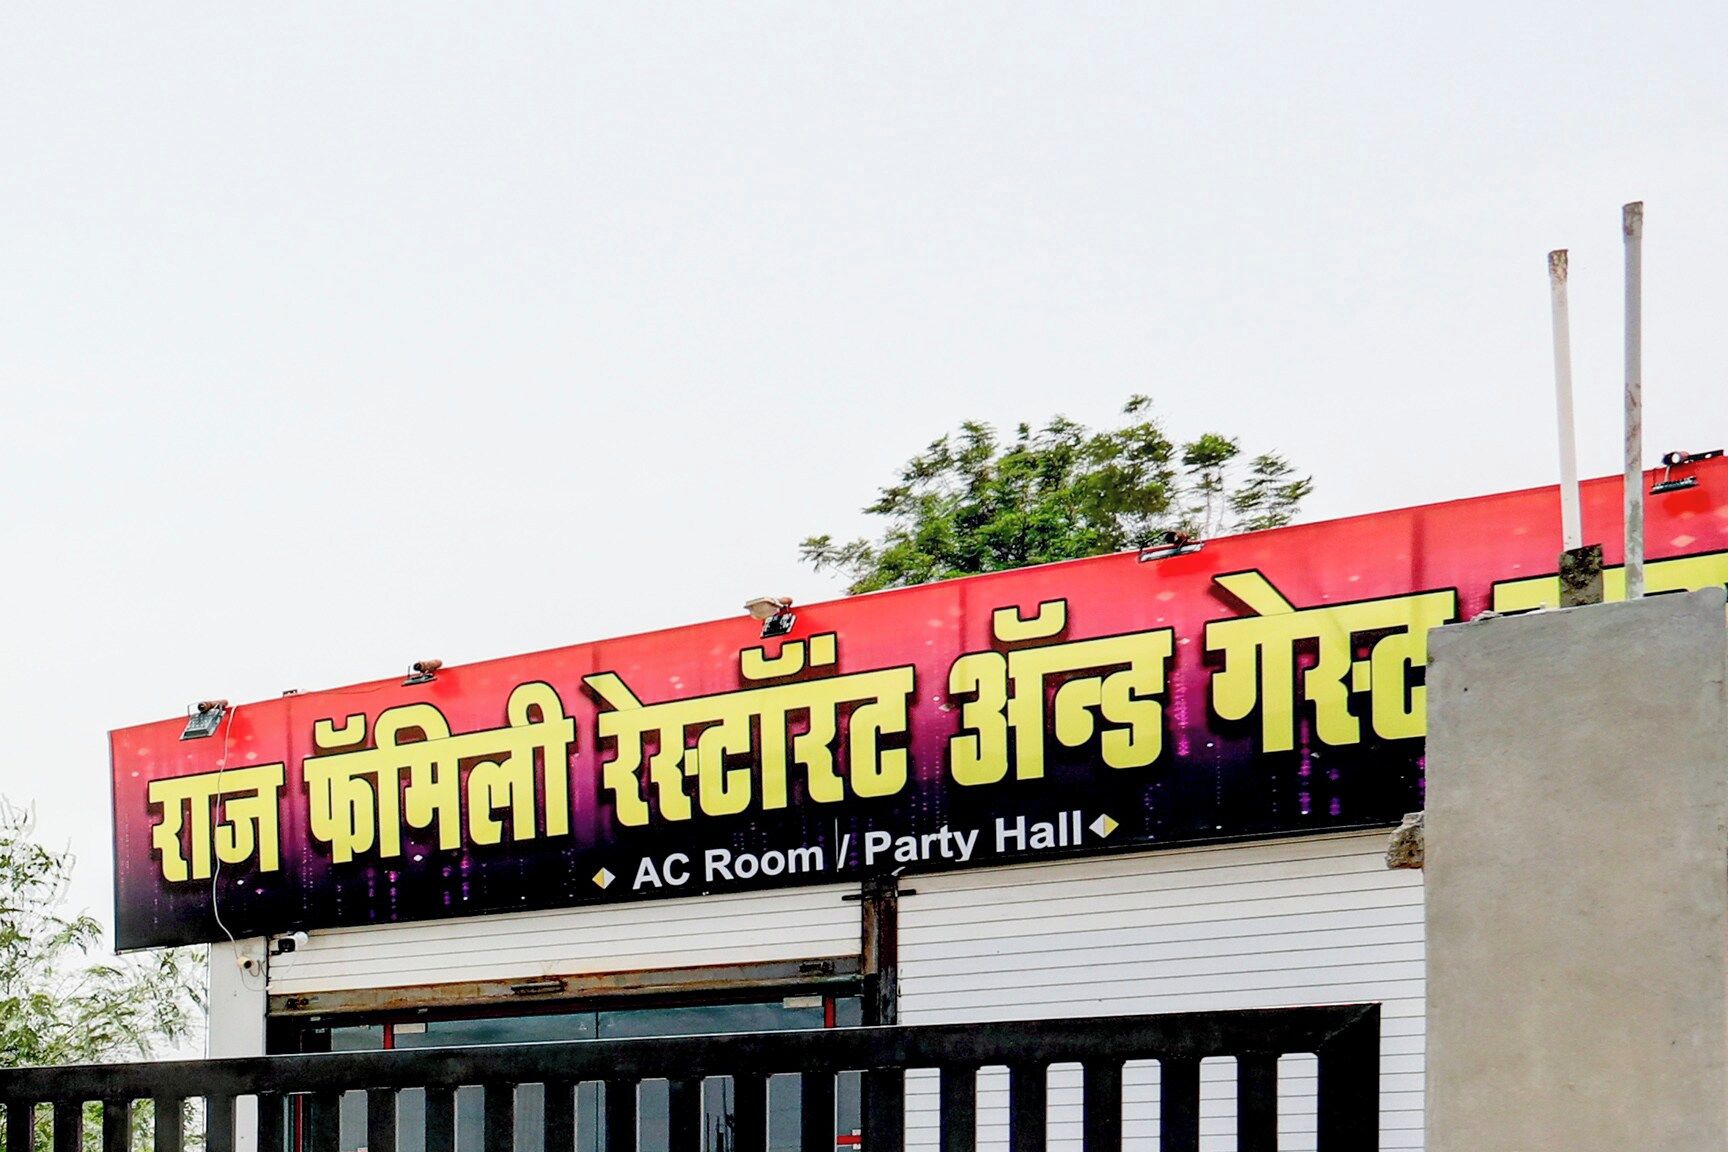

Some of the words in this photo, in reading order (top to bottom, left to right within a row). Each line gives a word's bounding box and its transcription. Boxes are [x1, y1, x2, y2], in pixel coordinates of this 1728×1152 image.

[148, 762, 285, 883] राज
[1205, 570, 1457, 753] गेस्ट
[632, 852, 691, 891] AC
[704, 843, 825, 883] Room
[865, 826, 980, 867] Party
[995, 810, 1083, 853] Hall
